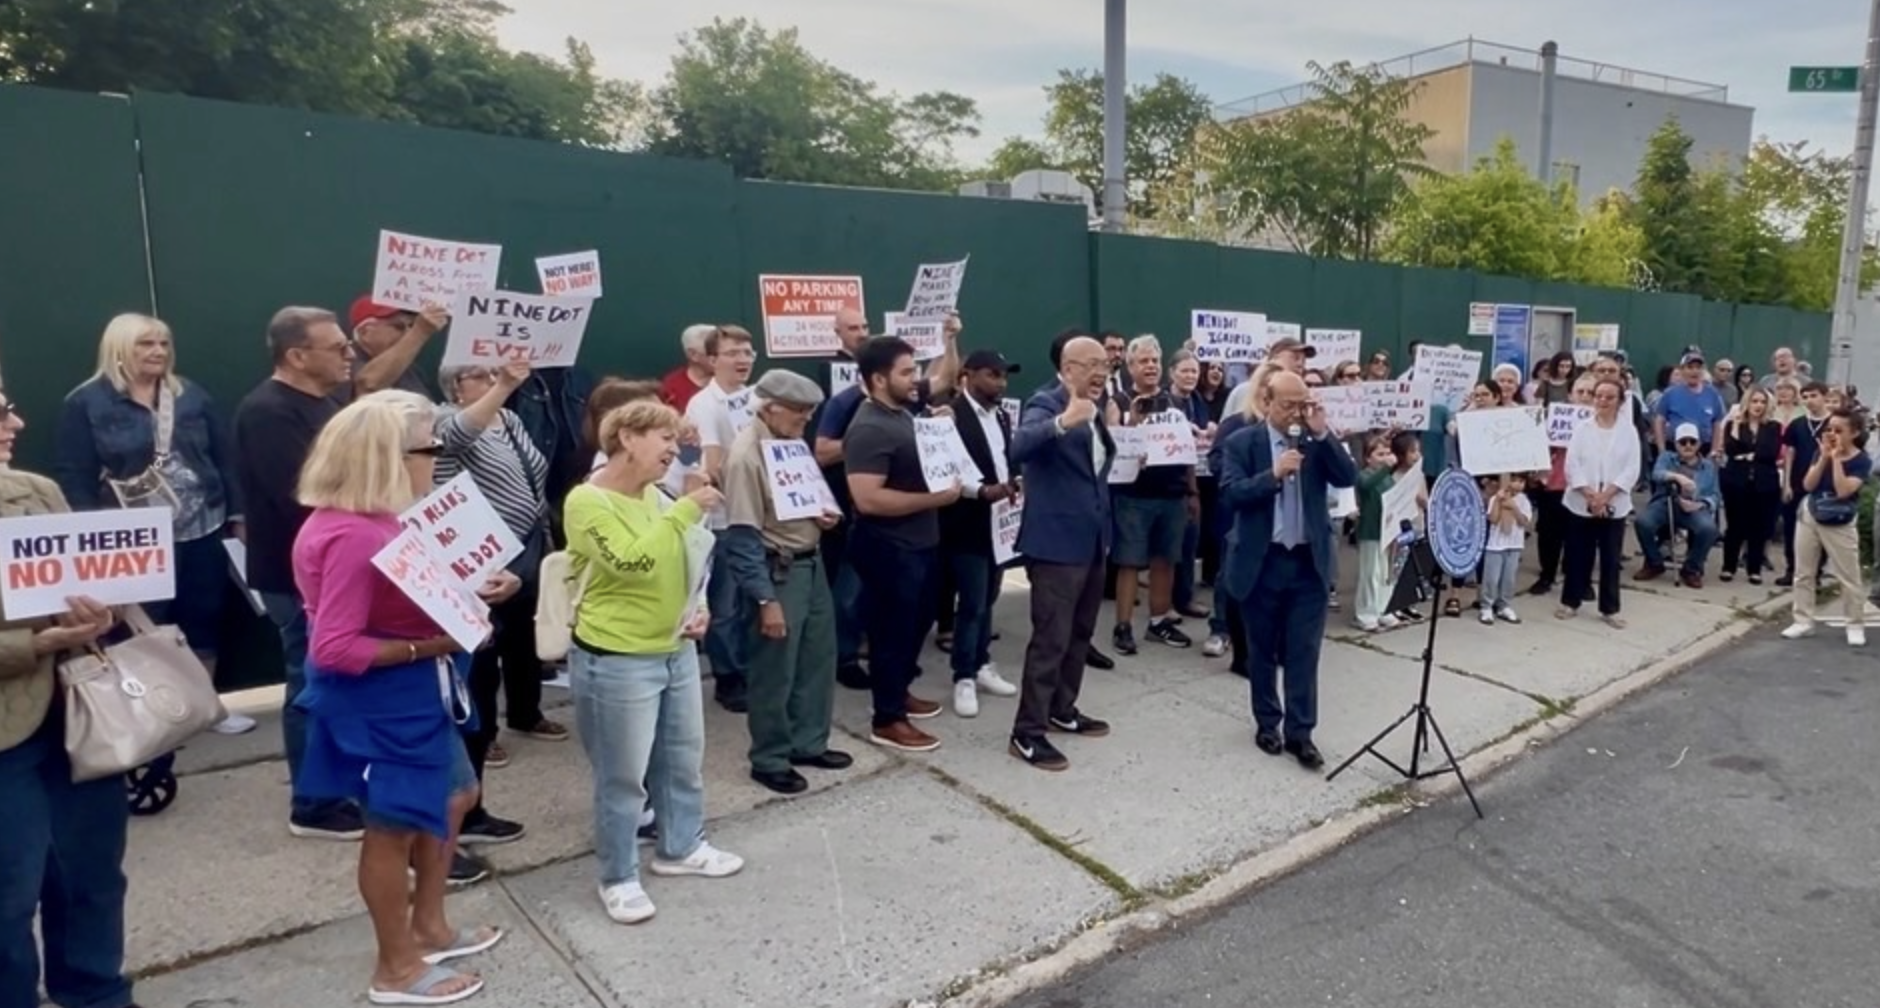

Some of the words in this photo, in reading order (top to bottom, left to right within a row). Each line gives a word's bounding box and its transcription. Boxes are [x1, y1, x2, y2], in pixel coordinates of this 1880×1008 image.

[1805, 70, 1826, 89] 65
[387, 236, 448, 261] NINE
[386, 259, 445, 279] ACROSS
[544, 265, 567, 279] NOT
[567, 261, 595, 276] HERE!
[397, 276, 409, 289] A
[545, 278, 567, 293] NO
[568, 271, 599, 289] WAY!
[765, 282, 788, 297] NO
[791, 282, 858, 297] PARKING
[382, 289, 412, 303] ARE
[783, 300, 810, 312] ANY
[496, 321, 531, 341] IS
[795, 321, 807, 332] 24
[773, 335, 809, 348] ACTIVE
[1197, 346, 1221, 358] OUR
[422, 485, 469, 525] MEANS
[12, 534, 70, 560] NOT
[78, 527, 159, 553] HERE!
[8, 557, 64, 591] NO
[73, 549, 167, 582] WAY!
